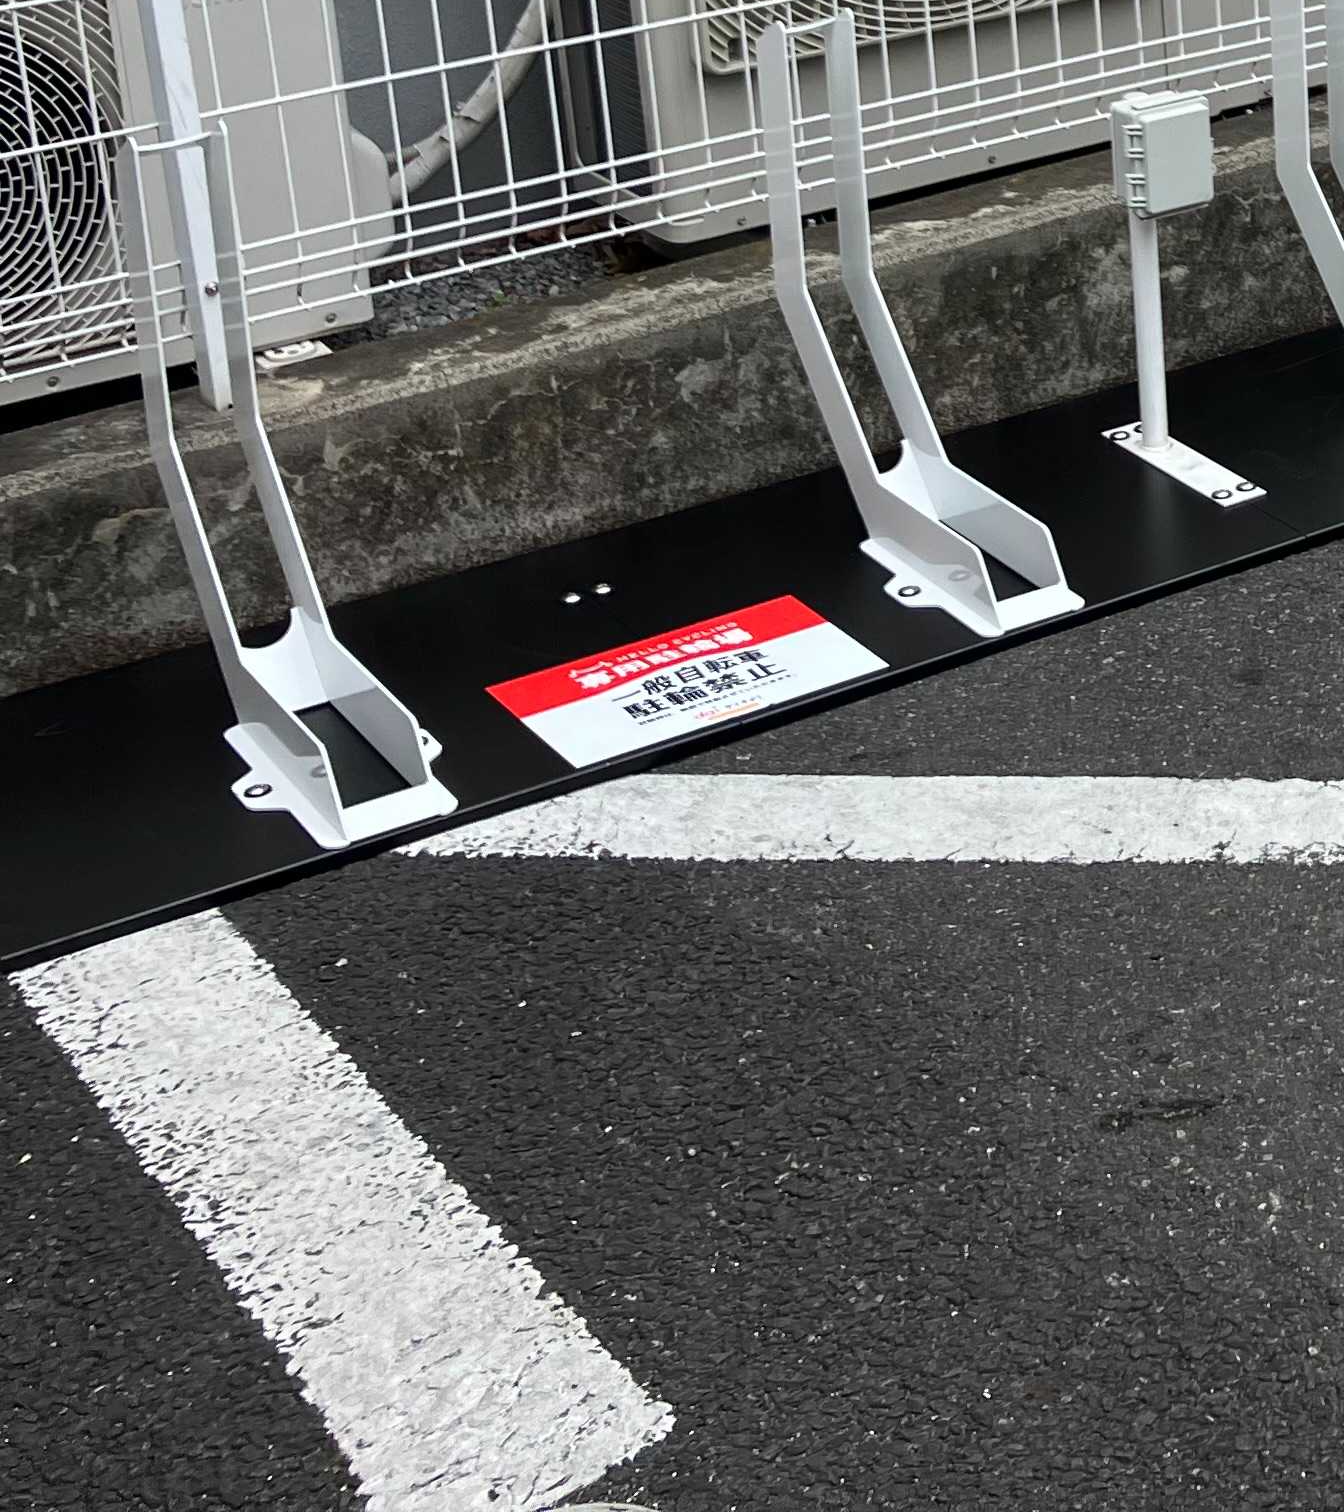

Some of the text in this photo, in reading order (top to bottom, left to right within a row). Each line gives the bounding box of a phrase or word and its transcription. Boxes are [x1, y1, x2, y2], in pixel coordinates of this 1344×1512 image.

[611, 648, 768, 702] 一般自転車
[623, 663, 787, 719] 駐輪禁止
